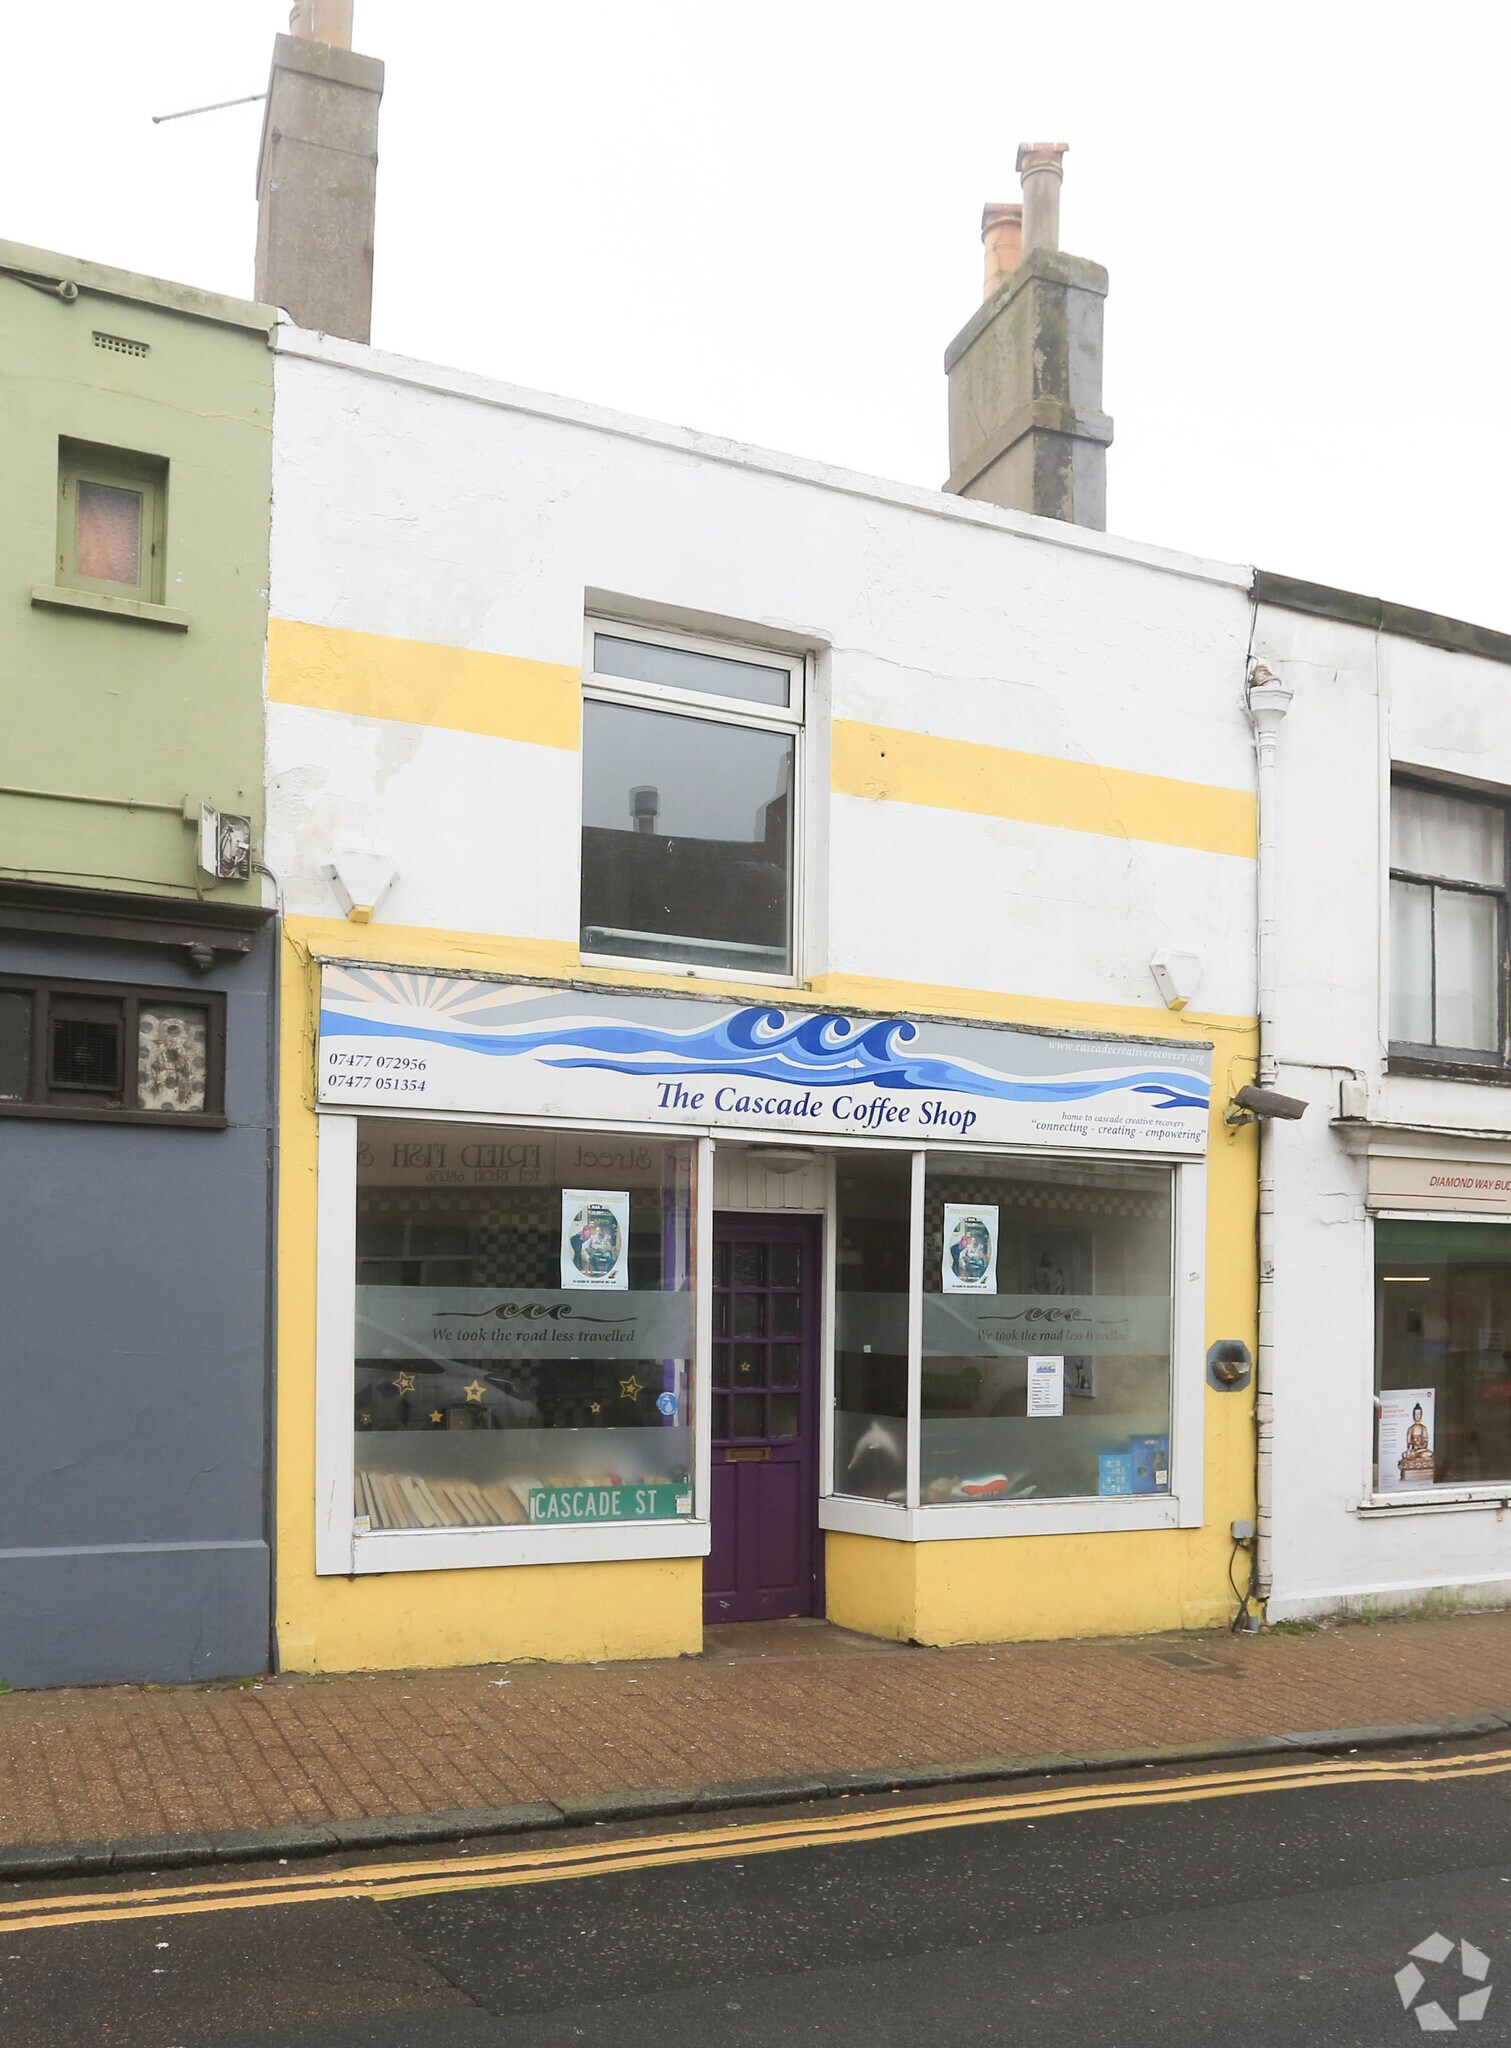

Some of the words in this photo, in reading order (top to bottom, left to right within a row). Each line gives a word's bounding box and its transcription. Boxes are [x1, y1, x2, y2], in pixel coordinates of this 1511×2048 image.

[329, 1053, 373, 1068] 07477
[376, 1056, 427, 1071] 072956
[328, 1074, 372, 1089] 07477
[375, 1077, 426, 1092] 051354
[657, 1082, 704, 1109] The
[714, 1087, 822, 1117] Cascade
[832, 1095, 910, 1129] Coffee
[918, 1101, 977, 1134] Shop
[1062, 1111, 1083, 1121] home
[1085, 1113, 1093, 1122] to
[1094, 1114, 1123, 1124] cascade
[1125, 1116, 1153, 1126] creative
[1155, 1119, 1185, 1128] recovery
[1098, 1125, 1136, 1139] creating
[1429, 1176, 1474, 1189] DIAMOND
[1475, 1178, 1494, 1190] WAY
[433, 1328, 452, 1341] We
[457, 1328, 486, 1341] took
[491, 1328, 512, 1341] the
[516, 1328, 548, 1342] road
[551, 1329, 574, 1342] less
[578, 1329, 635, 1342] travelled
[995, 1329, 1017, 1341] took
[1021, 1329, 1037, 1341] the
[1039, 1329, 1063, 1342] road
[1066, 1329, 1083, 1341] less
[535, 1491, 621, 1519] CASCADE
[635, 1490, 657, 1514] ST
